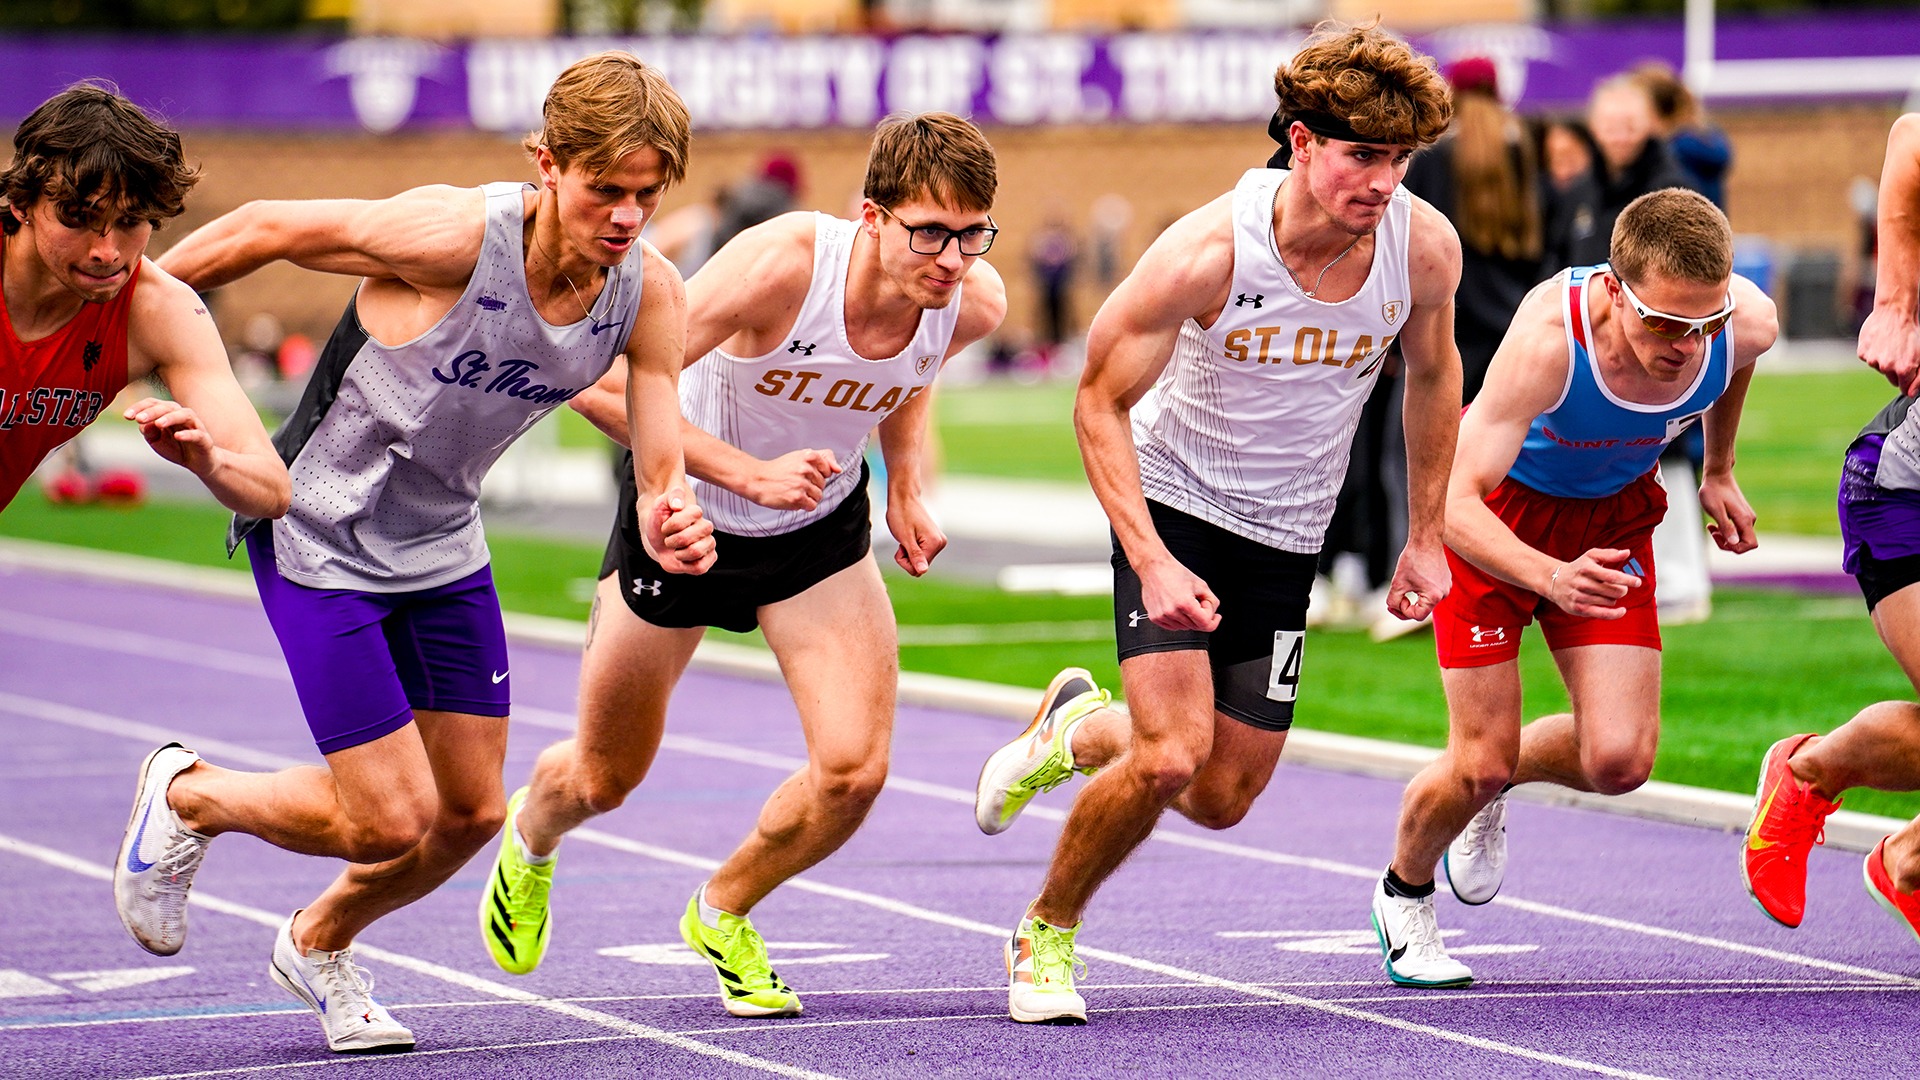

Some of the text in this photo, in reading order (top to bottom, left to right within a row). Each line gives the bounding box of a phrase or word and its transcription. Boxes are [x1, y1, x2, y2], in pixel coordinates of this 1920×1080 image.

[1224, 326, 1281, 364] ST.
[431, 350, 578, 404] St. Thom
[754, 369, 822, 404] ST.
[1542, 426, 1620, 448] SAINT
[1278, 635, 1304, 698] 4
